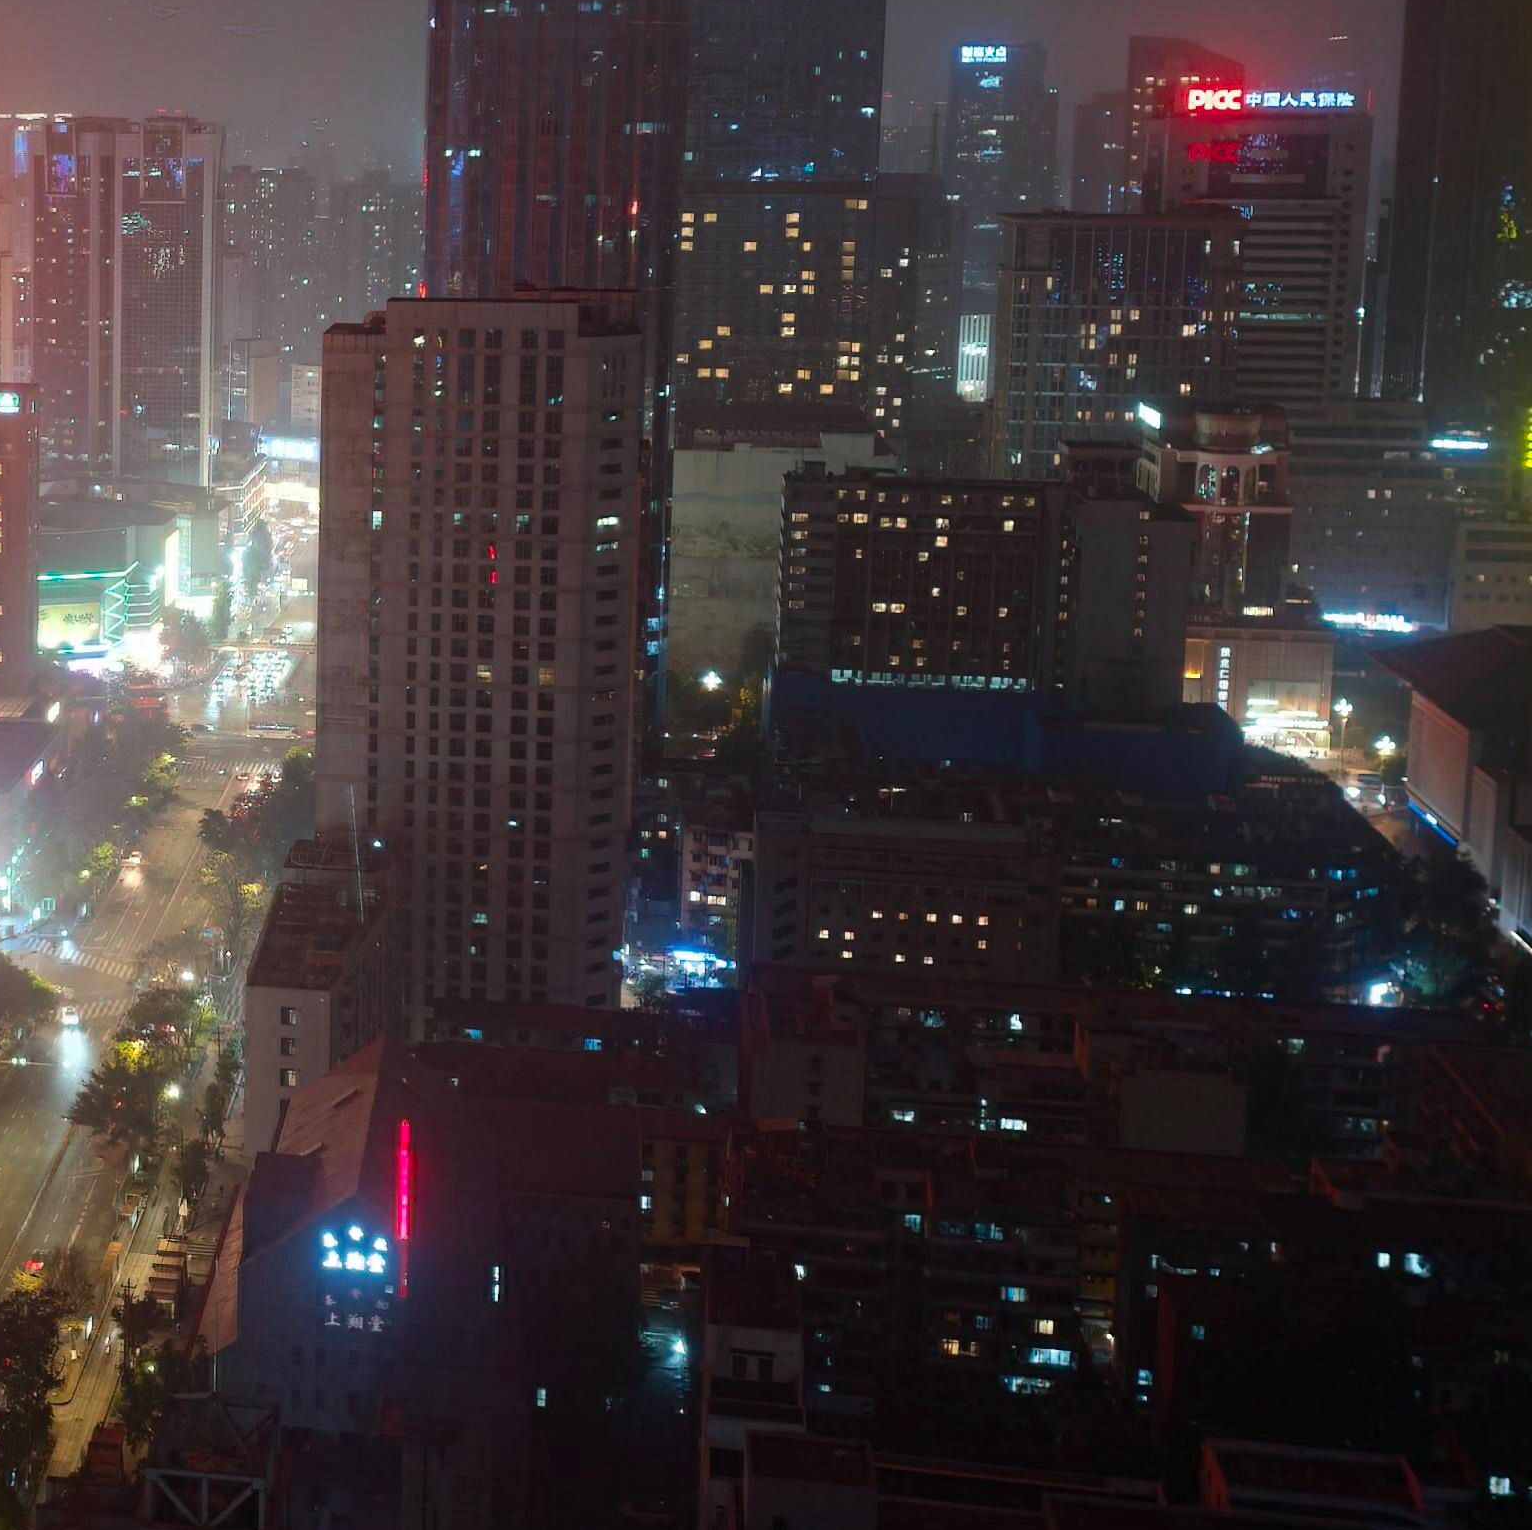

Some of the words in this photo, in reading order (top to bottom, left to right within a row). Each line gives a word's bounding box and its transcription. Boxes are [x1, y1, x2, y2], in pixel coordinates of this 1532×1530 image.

[1187, 89, 1242, 110] PICC
[1245, 91, 1356, 108] 中国人民保险
